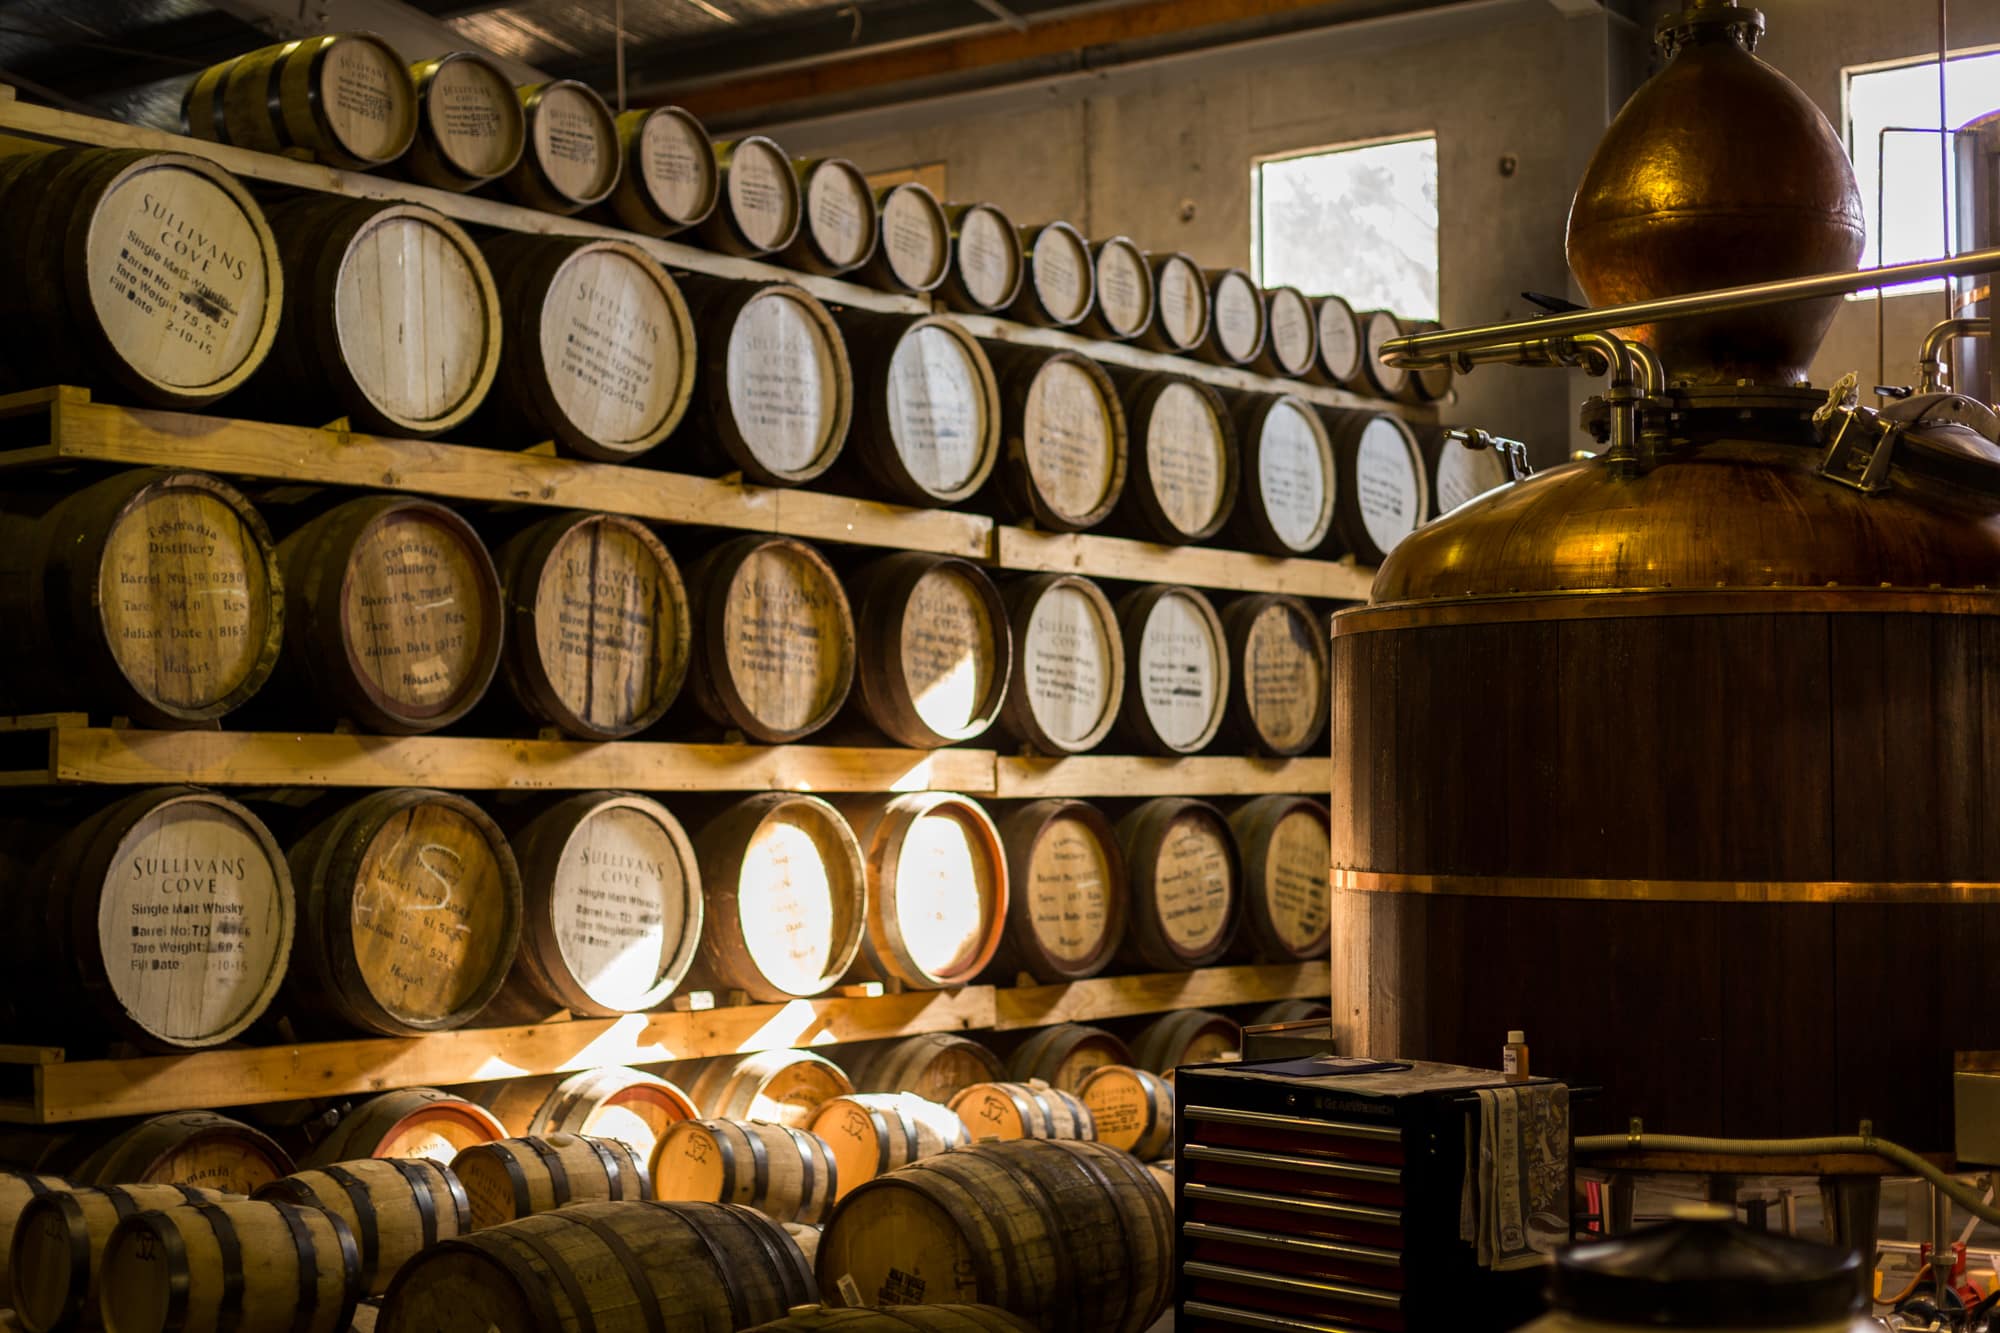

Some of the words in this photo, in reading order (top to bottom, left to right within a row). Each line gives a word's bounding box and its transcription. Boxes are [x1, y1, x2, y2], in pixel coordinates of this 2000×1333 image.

[127, 229, 162, 262] Single
[138, 193, 247, 280] SULLIVANS
[161, 231, 212, 274] COVE
[120, 247, 154, 279] Barrel
[116, 263, 137, 285] Tare
[109, 275, 126, 294] Fill
[165, 319, 213, 355] 2-10-15
[146, 520, 217, 541] Tasmania
[149, 542, 215, 557] Distillery
[120, 572, 161, 585] Barrel
[122, 626, 162, 640] Julian
[170, 627, 202, 640] Date
[164, 658, 210, 674] Hobart
[132, 857, 246, 881] SULLIVANS
[579, 847, 664, 882] SULLIVANS
[161, 877, 217, 894] COVE
[601, 870, 641, 888] COVE
[131, 903, 169, 917] Single
[172, 903, 199, 915] Malt
[202, 902, 245, 916] Whisky
[131, 926, 167, 937] Barrel
[132, 942, 156, 954] Tare
